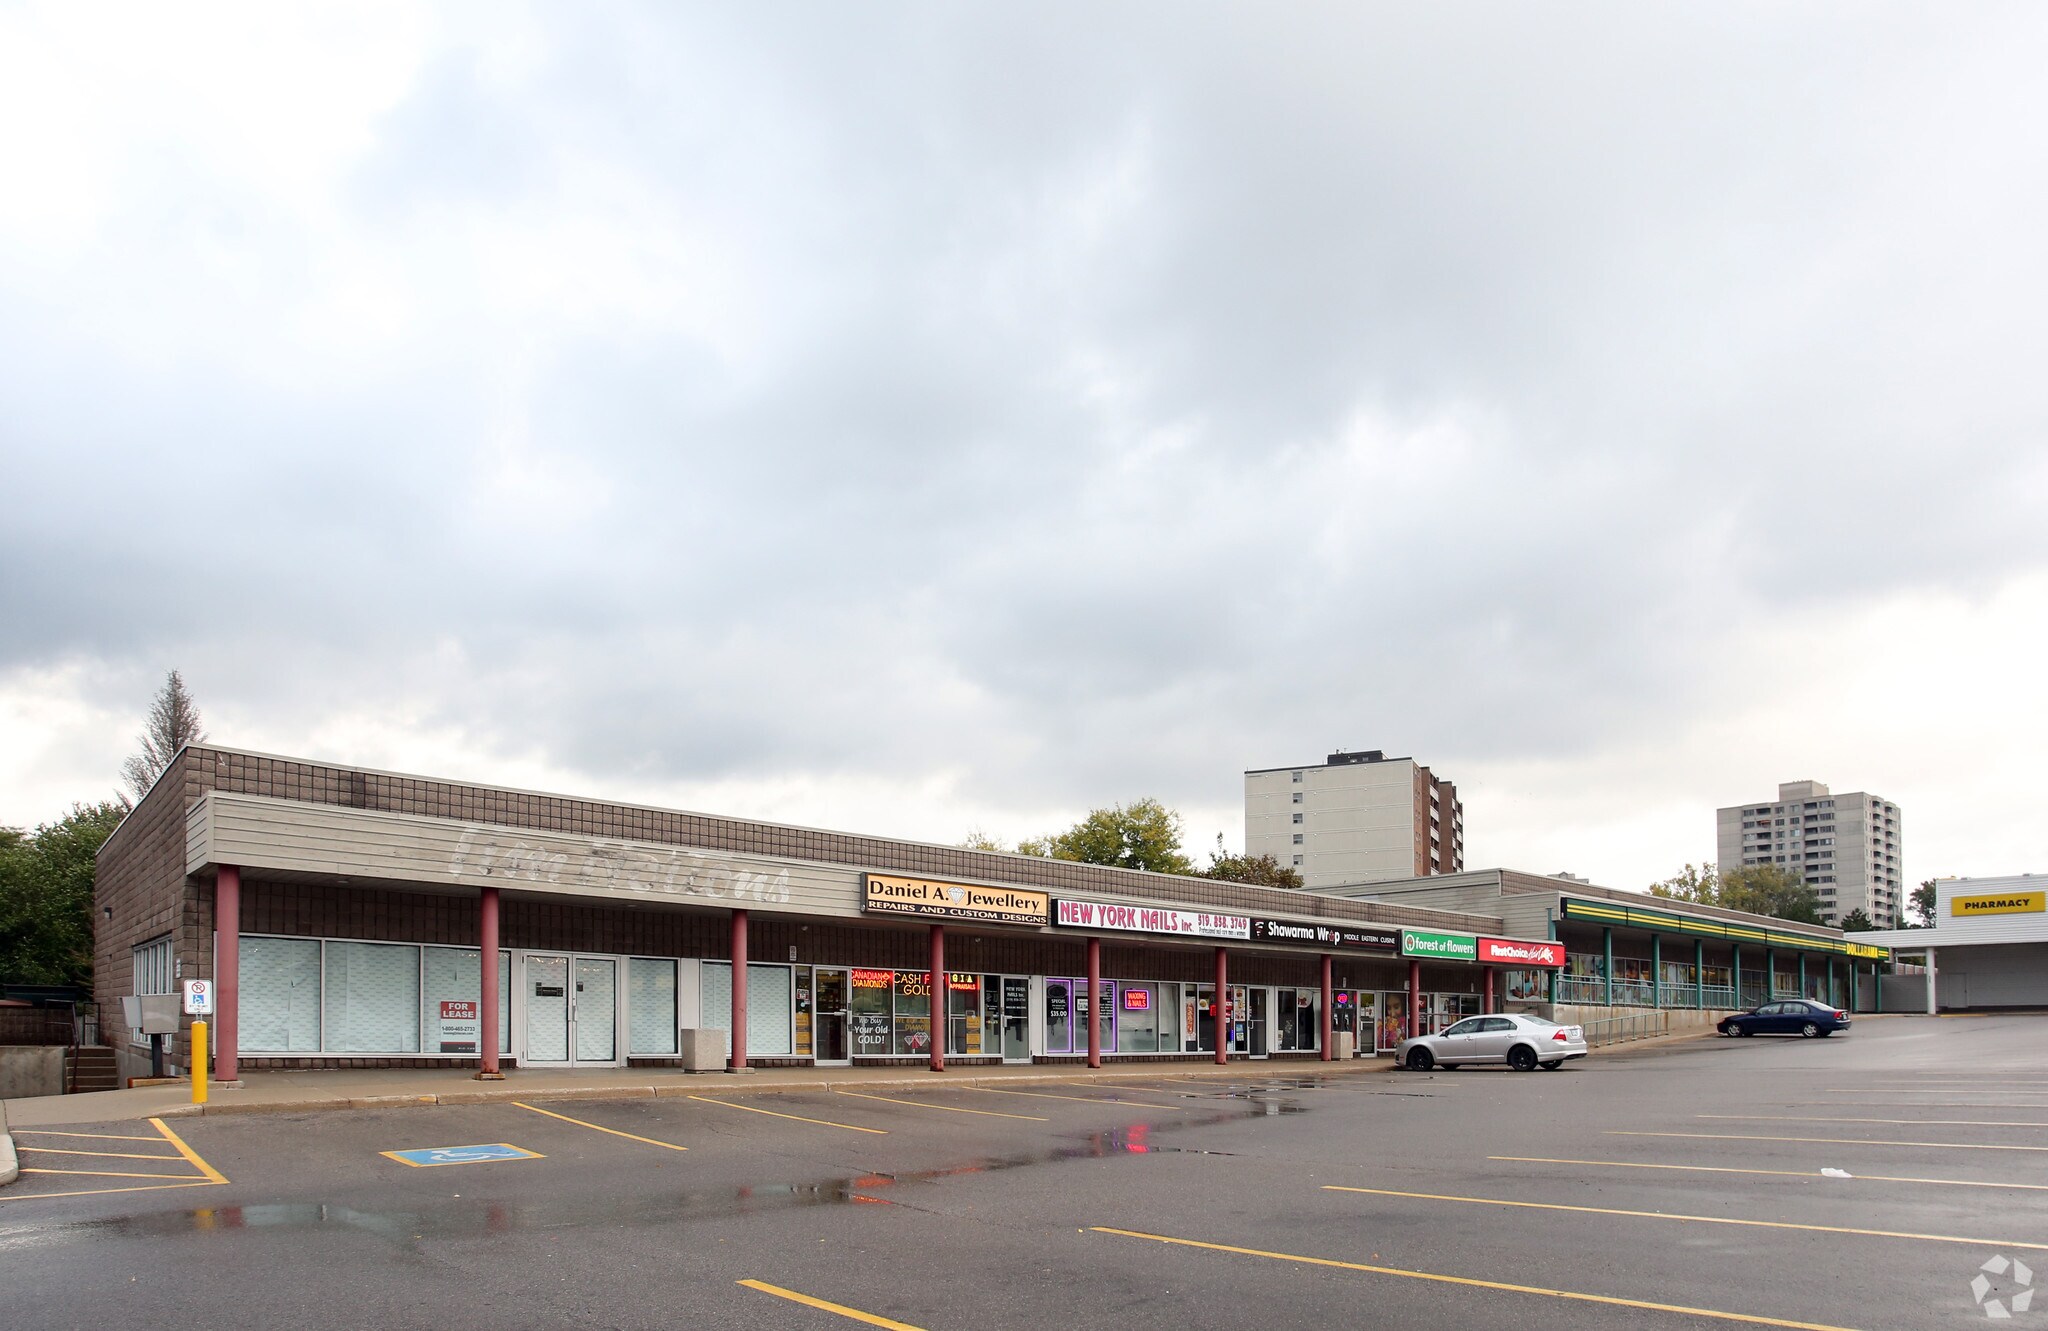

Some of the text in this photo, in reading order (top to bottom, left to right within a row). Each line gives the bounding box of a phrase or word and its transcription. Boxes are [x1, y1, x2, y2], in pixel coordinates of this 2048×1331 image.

[870, 880, 1040, 914] Daniel A. Jewellery
[1964, 898, 2030, 910] PHARMACY
[868, 901, 916, 912] REPAIRS
[919, 905, 946, 915] AND
[950, 908, 998, 920] CUSTOM
[1001, 912, 1047, 924] DESIGNS
[1060, 901, 1093, 924] NEW
[1097, 904, 1136, 928] YORK
[1140, 909, 1178, 931] NAILS
[1197, 914, 1212, 927] 519.
[1268, 921, 1314, 940] Shawarma
[1343, 933, 1396, 945] MIDDLE EASTERN CUISINE
[1416, 937, 1474, 954] forest of flowers
[1846, 942, 1878, 959] DOLLARAMA
[850, 970, 883, 981] CANADIAN
[893, 973, 921, 984] CASH
[852, 979, 888, 989] DIAMONDS
[1127, 992, 1146, 1000] WAXING
[448, 1002, 468, 1010] FOR
[1132, 1000, 1146, 1008] NAILS
[442, 1010, 474, 1018] LEASE
[870, 1017, 883, 1026] Buy
[854, 1026, 888, 1034] Your Old
[857, 1035, 885, 1044] GOLD!
